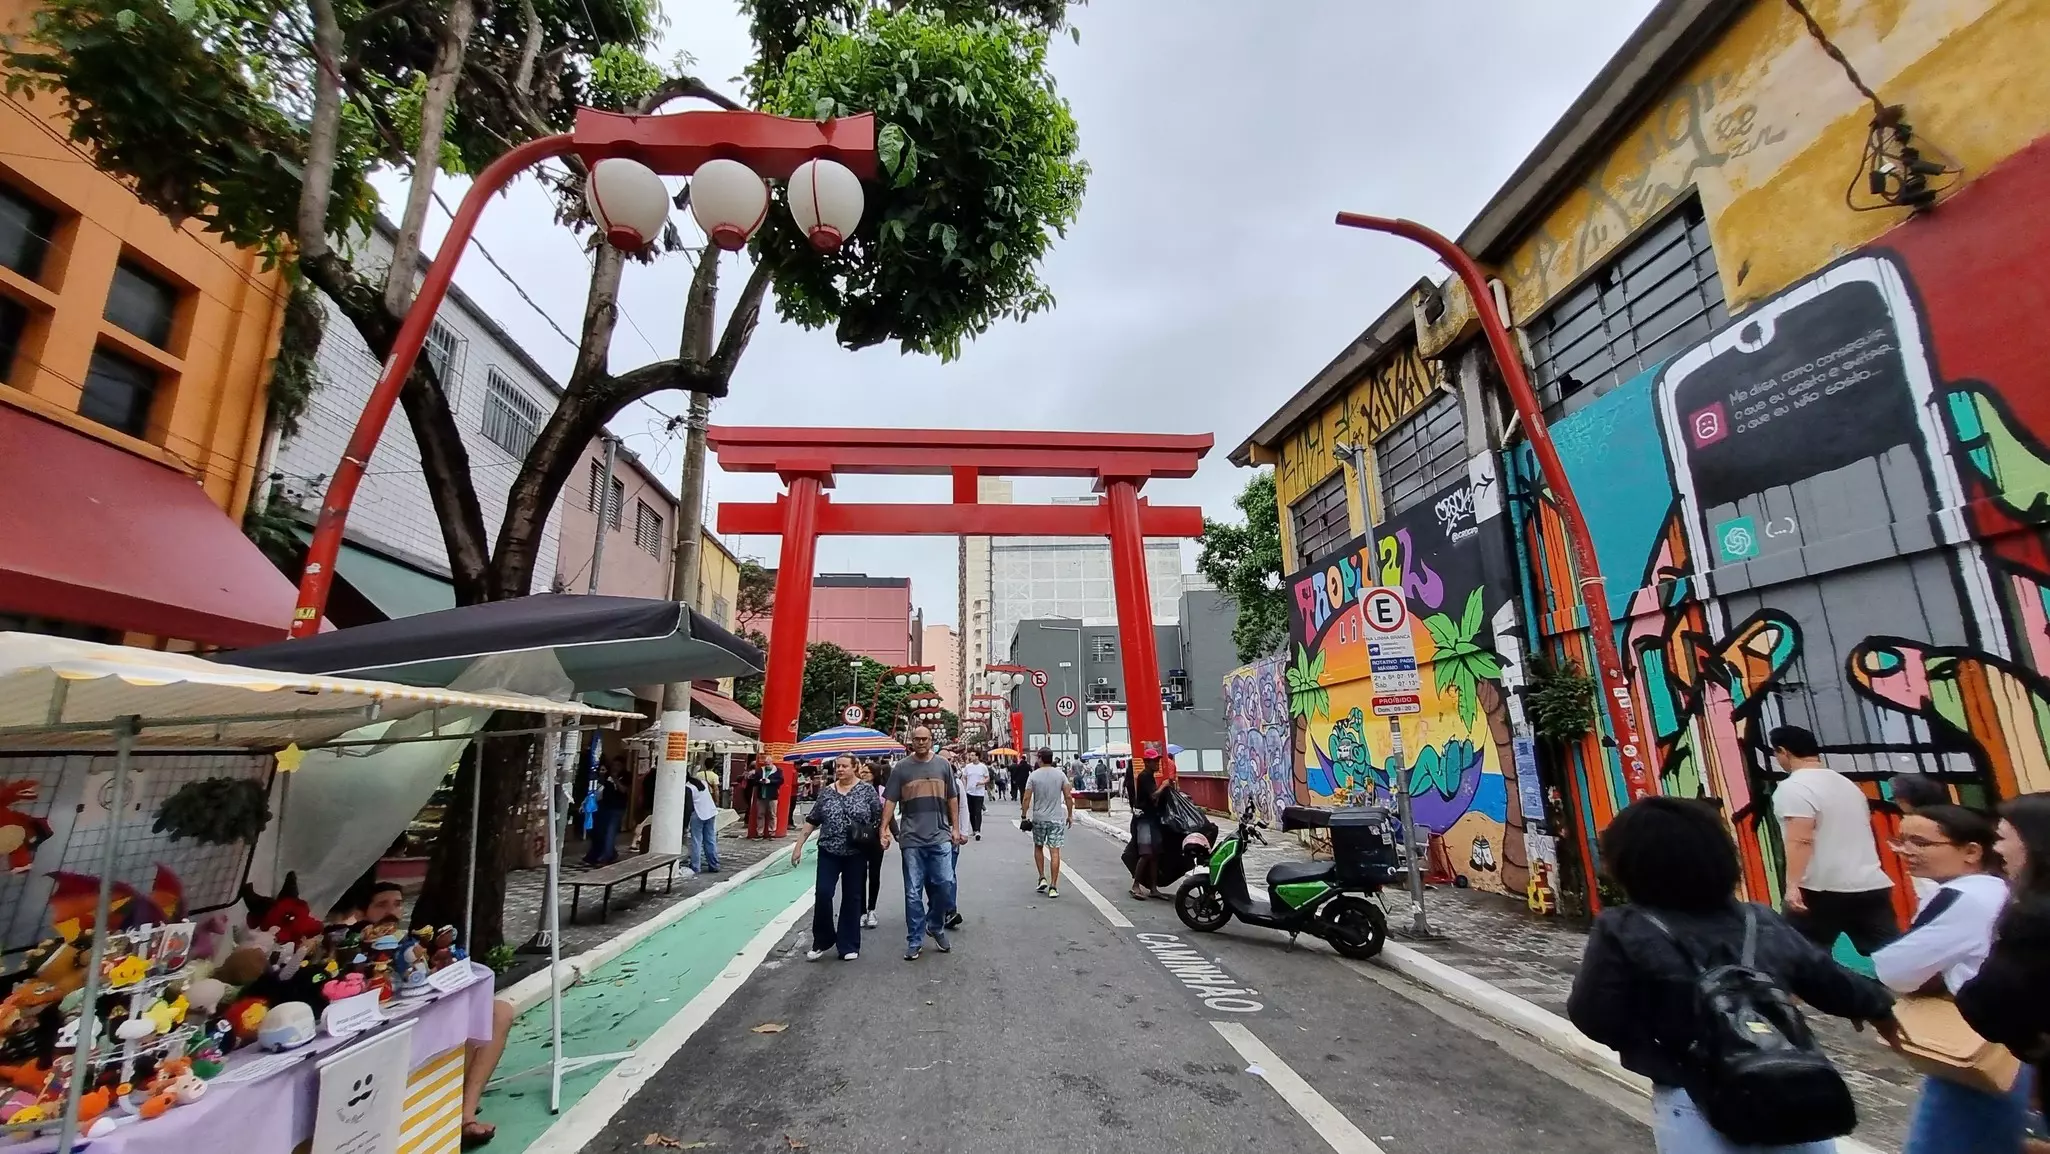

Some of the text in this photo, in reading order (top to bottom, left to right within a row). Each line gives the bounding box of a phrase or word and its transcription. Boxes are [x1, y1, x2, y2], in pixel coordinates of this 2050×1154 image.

[1375, 598, 1394, 623] E
[1036, 674, 1044, 685] E
[1059, 700, 1073, 710] 40
[847, 708, 861, 718] 40
[1136, 932, 1264, 1013] CAMINHÃO
